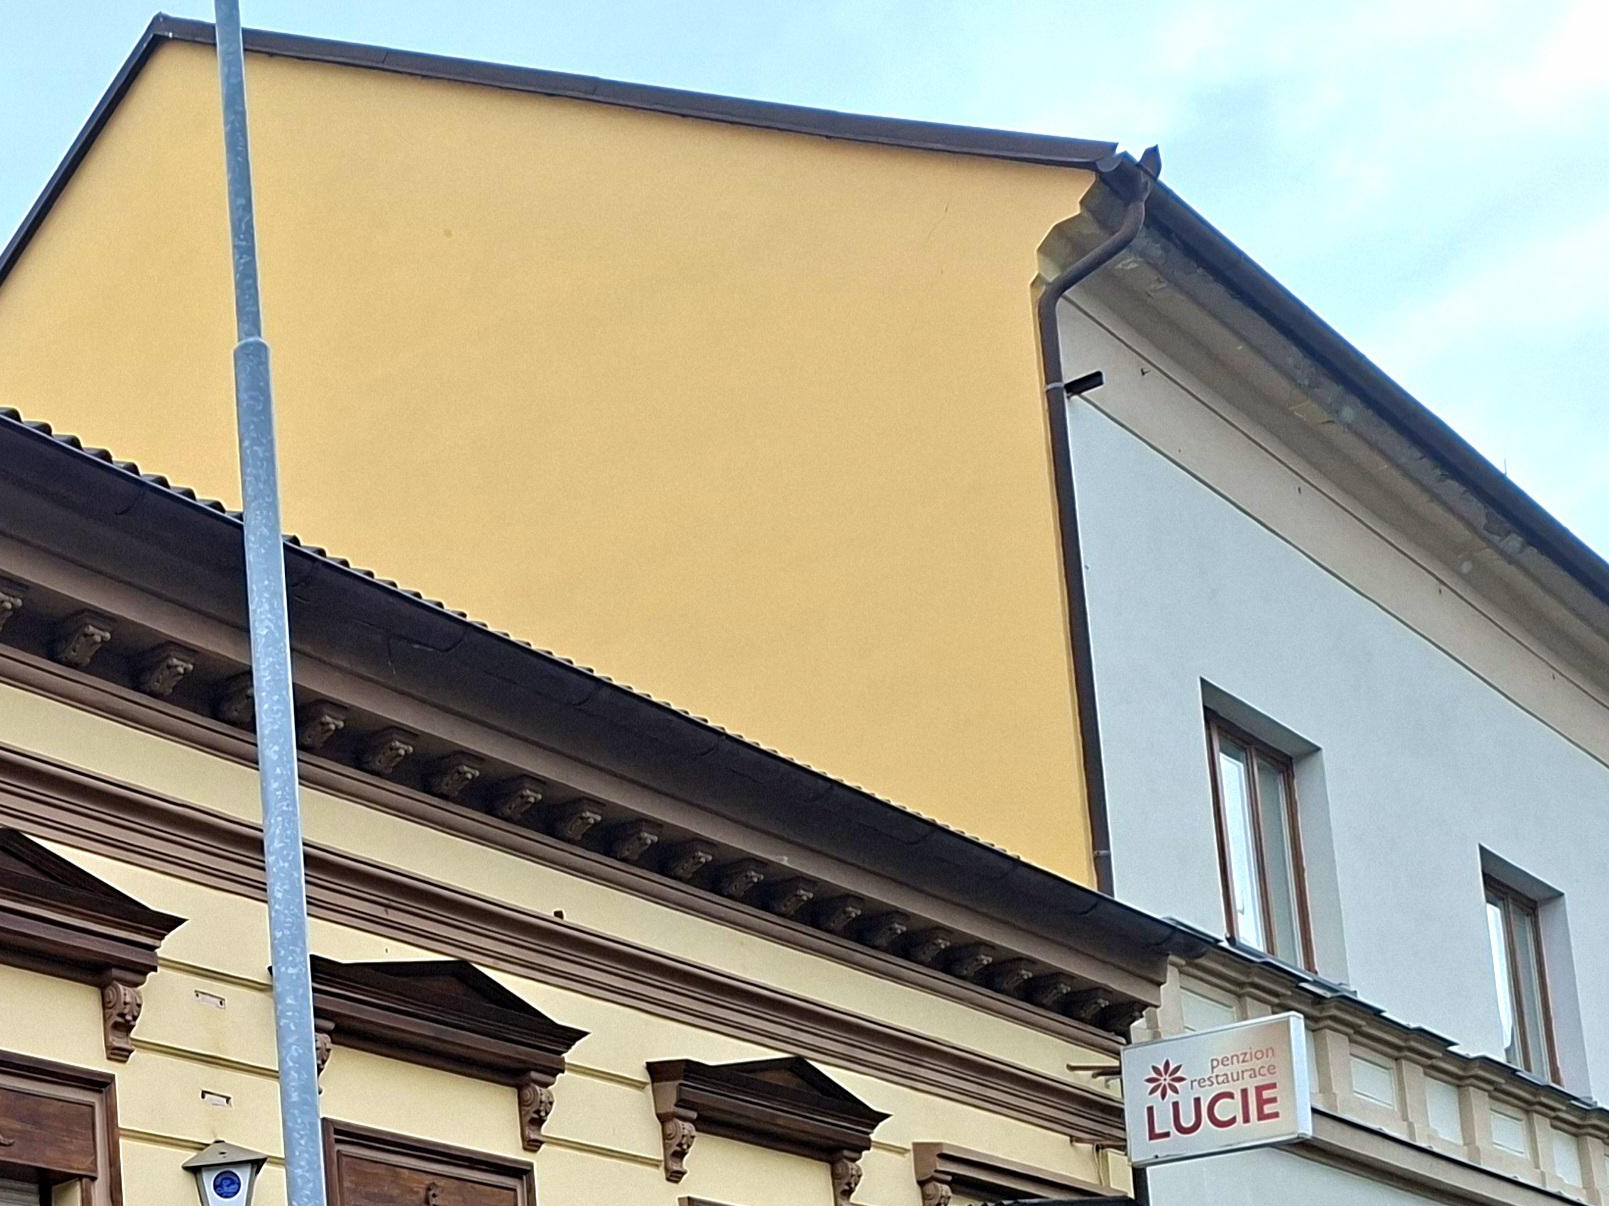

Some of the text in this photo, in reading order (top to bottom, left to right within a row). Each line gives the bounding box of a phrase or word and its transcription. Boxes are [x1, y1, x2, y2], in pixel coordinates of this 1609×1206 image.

[1210, 1046, 1275, 1074] penzion
[1190, 1062, 1277, 1091] restaurace
[1146, 1082, 1280, 1141] LUCIE
